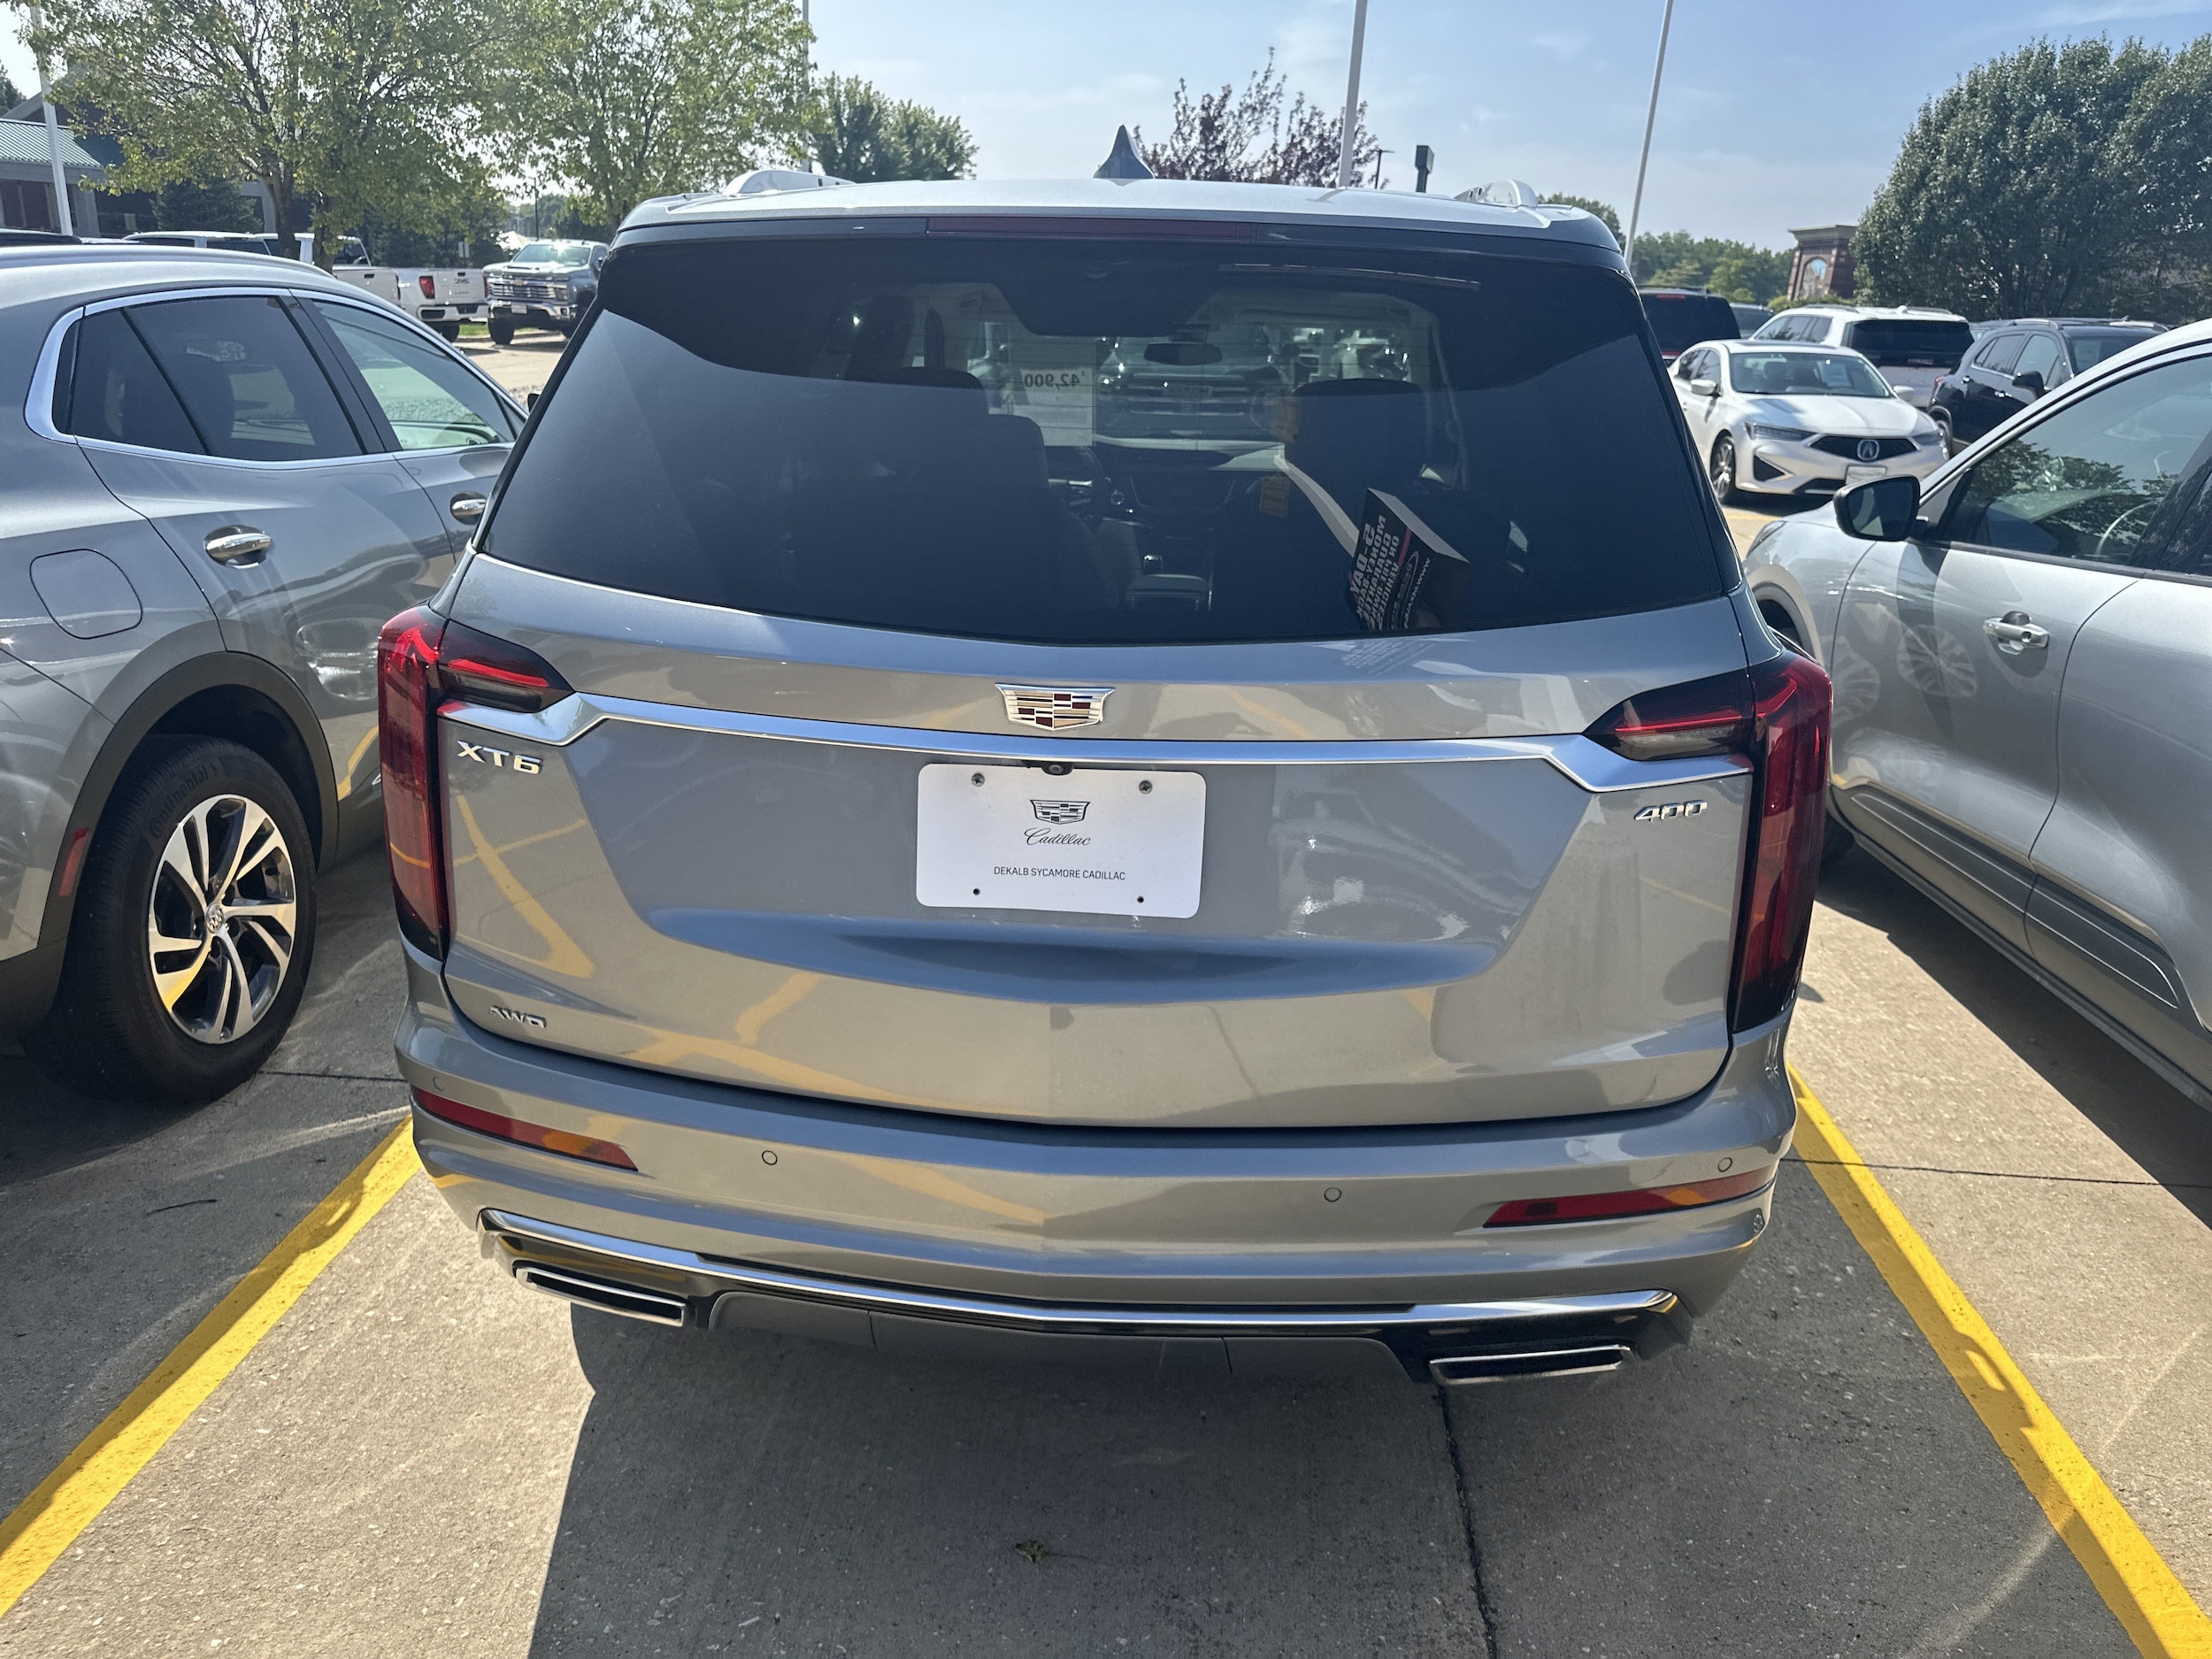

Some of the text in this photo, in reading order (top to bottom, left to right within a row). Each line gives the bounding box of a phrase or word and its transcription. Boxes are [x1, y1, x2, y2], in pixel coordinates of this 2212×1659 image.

[457, 739, 541, 775] XT6
[1634, 800, 1708, 823] 400
[1024, 827, 1091, 847] Cadillac
[994, 866, 1126, 881] DEKALB SYCAMORE CADILLAC
[489, 1005, 547, 1029] AWD
